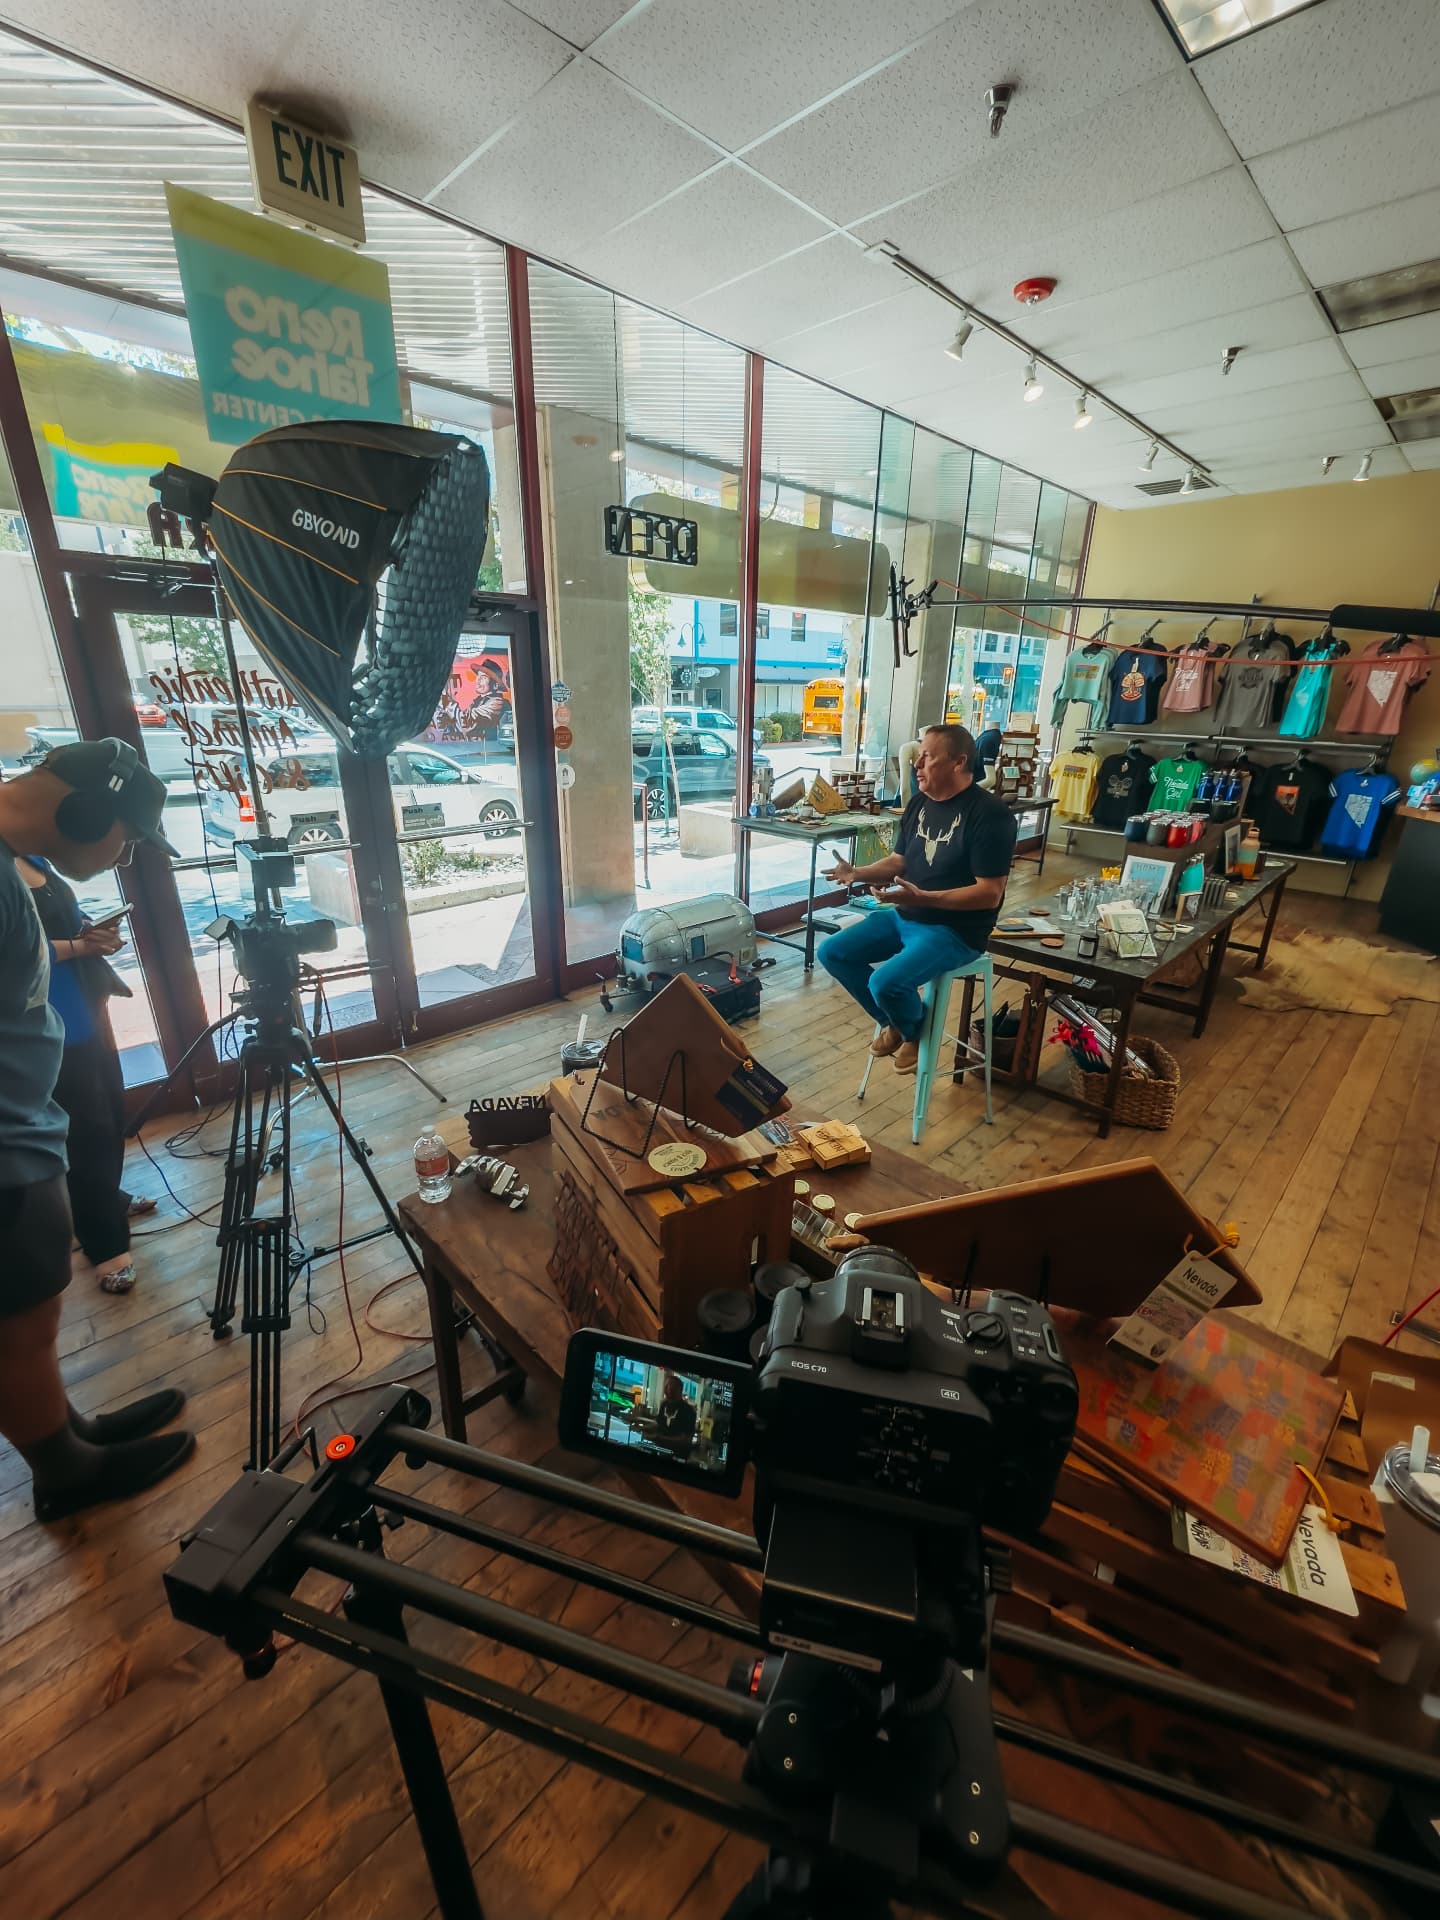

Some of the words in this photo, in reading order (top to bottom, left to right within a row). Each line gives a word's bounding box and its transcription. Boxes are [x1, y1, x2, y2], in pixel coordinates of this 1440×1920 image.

[272, 120, 345, 208] EXIT
[291, 508, 360, 549] GBYOND
[292, 815, 317, 824] Push
[402, 806, 424, 815] Push
[1182, 1266, 1219, 1297] Nevada
[791, 1360, 810, 1370] EOS
[811, 1364, 827, 1373] C70
[942, 1390, 958, 1400] 4K
[1300, 1515, 1327, 1587] Nevada
